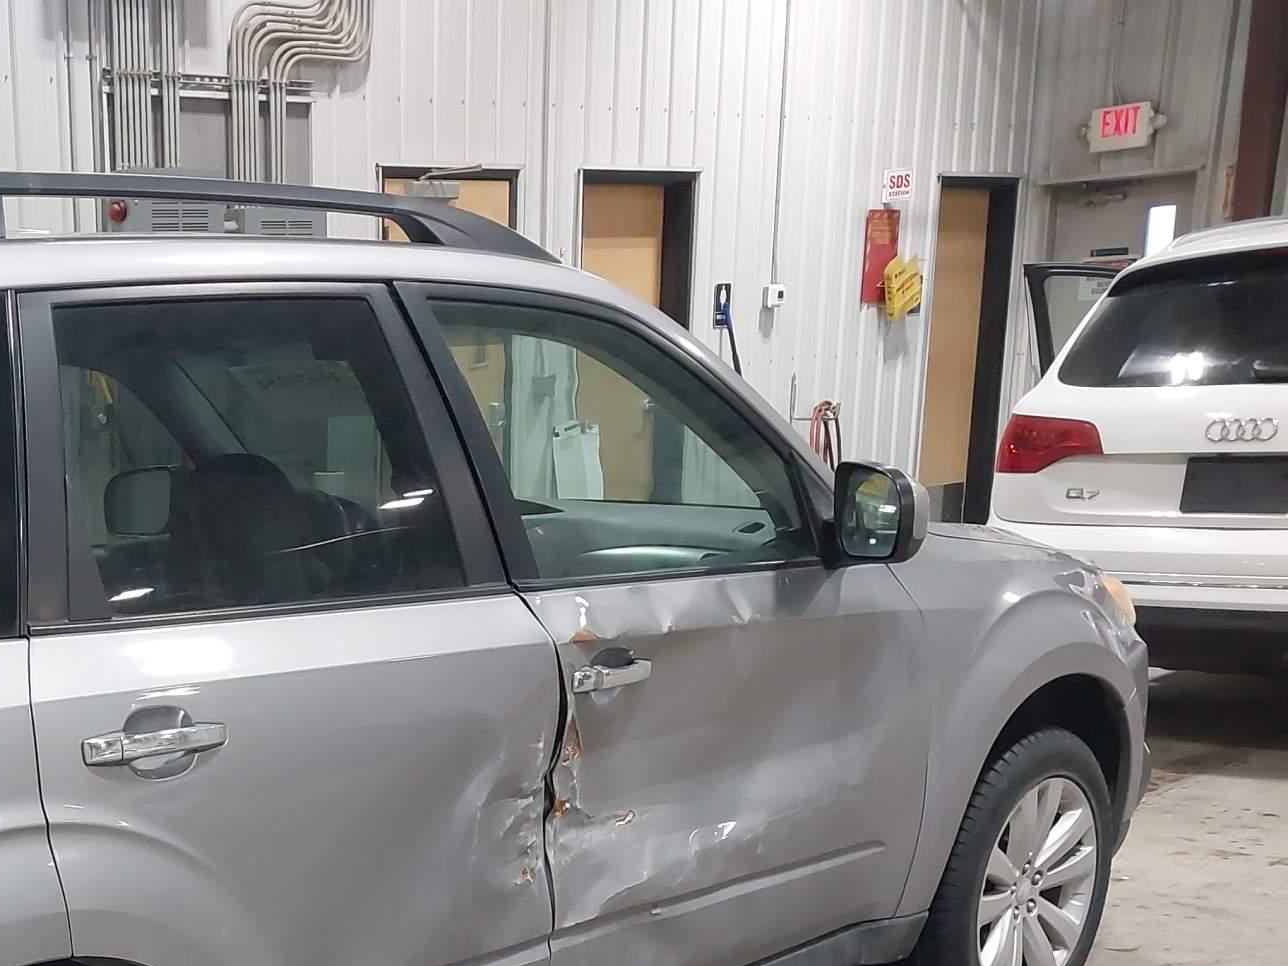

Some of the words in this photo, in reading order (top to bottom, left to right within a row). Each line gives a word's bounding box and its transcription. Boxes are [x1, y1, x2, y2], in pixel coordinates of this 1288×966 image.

[1100, 106, 1141, 138] EXIT
[889, 173, 910, 190] SDS
[888, 190, 910, 198] STATION
[1065, 487, 1100, 501] Q7
